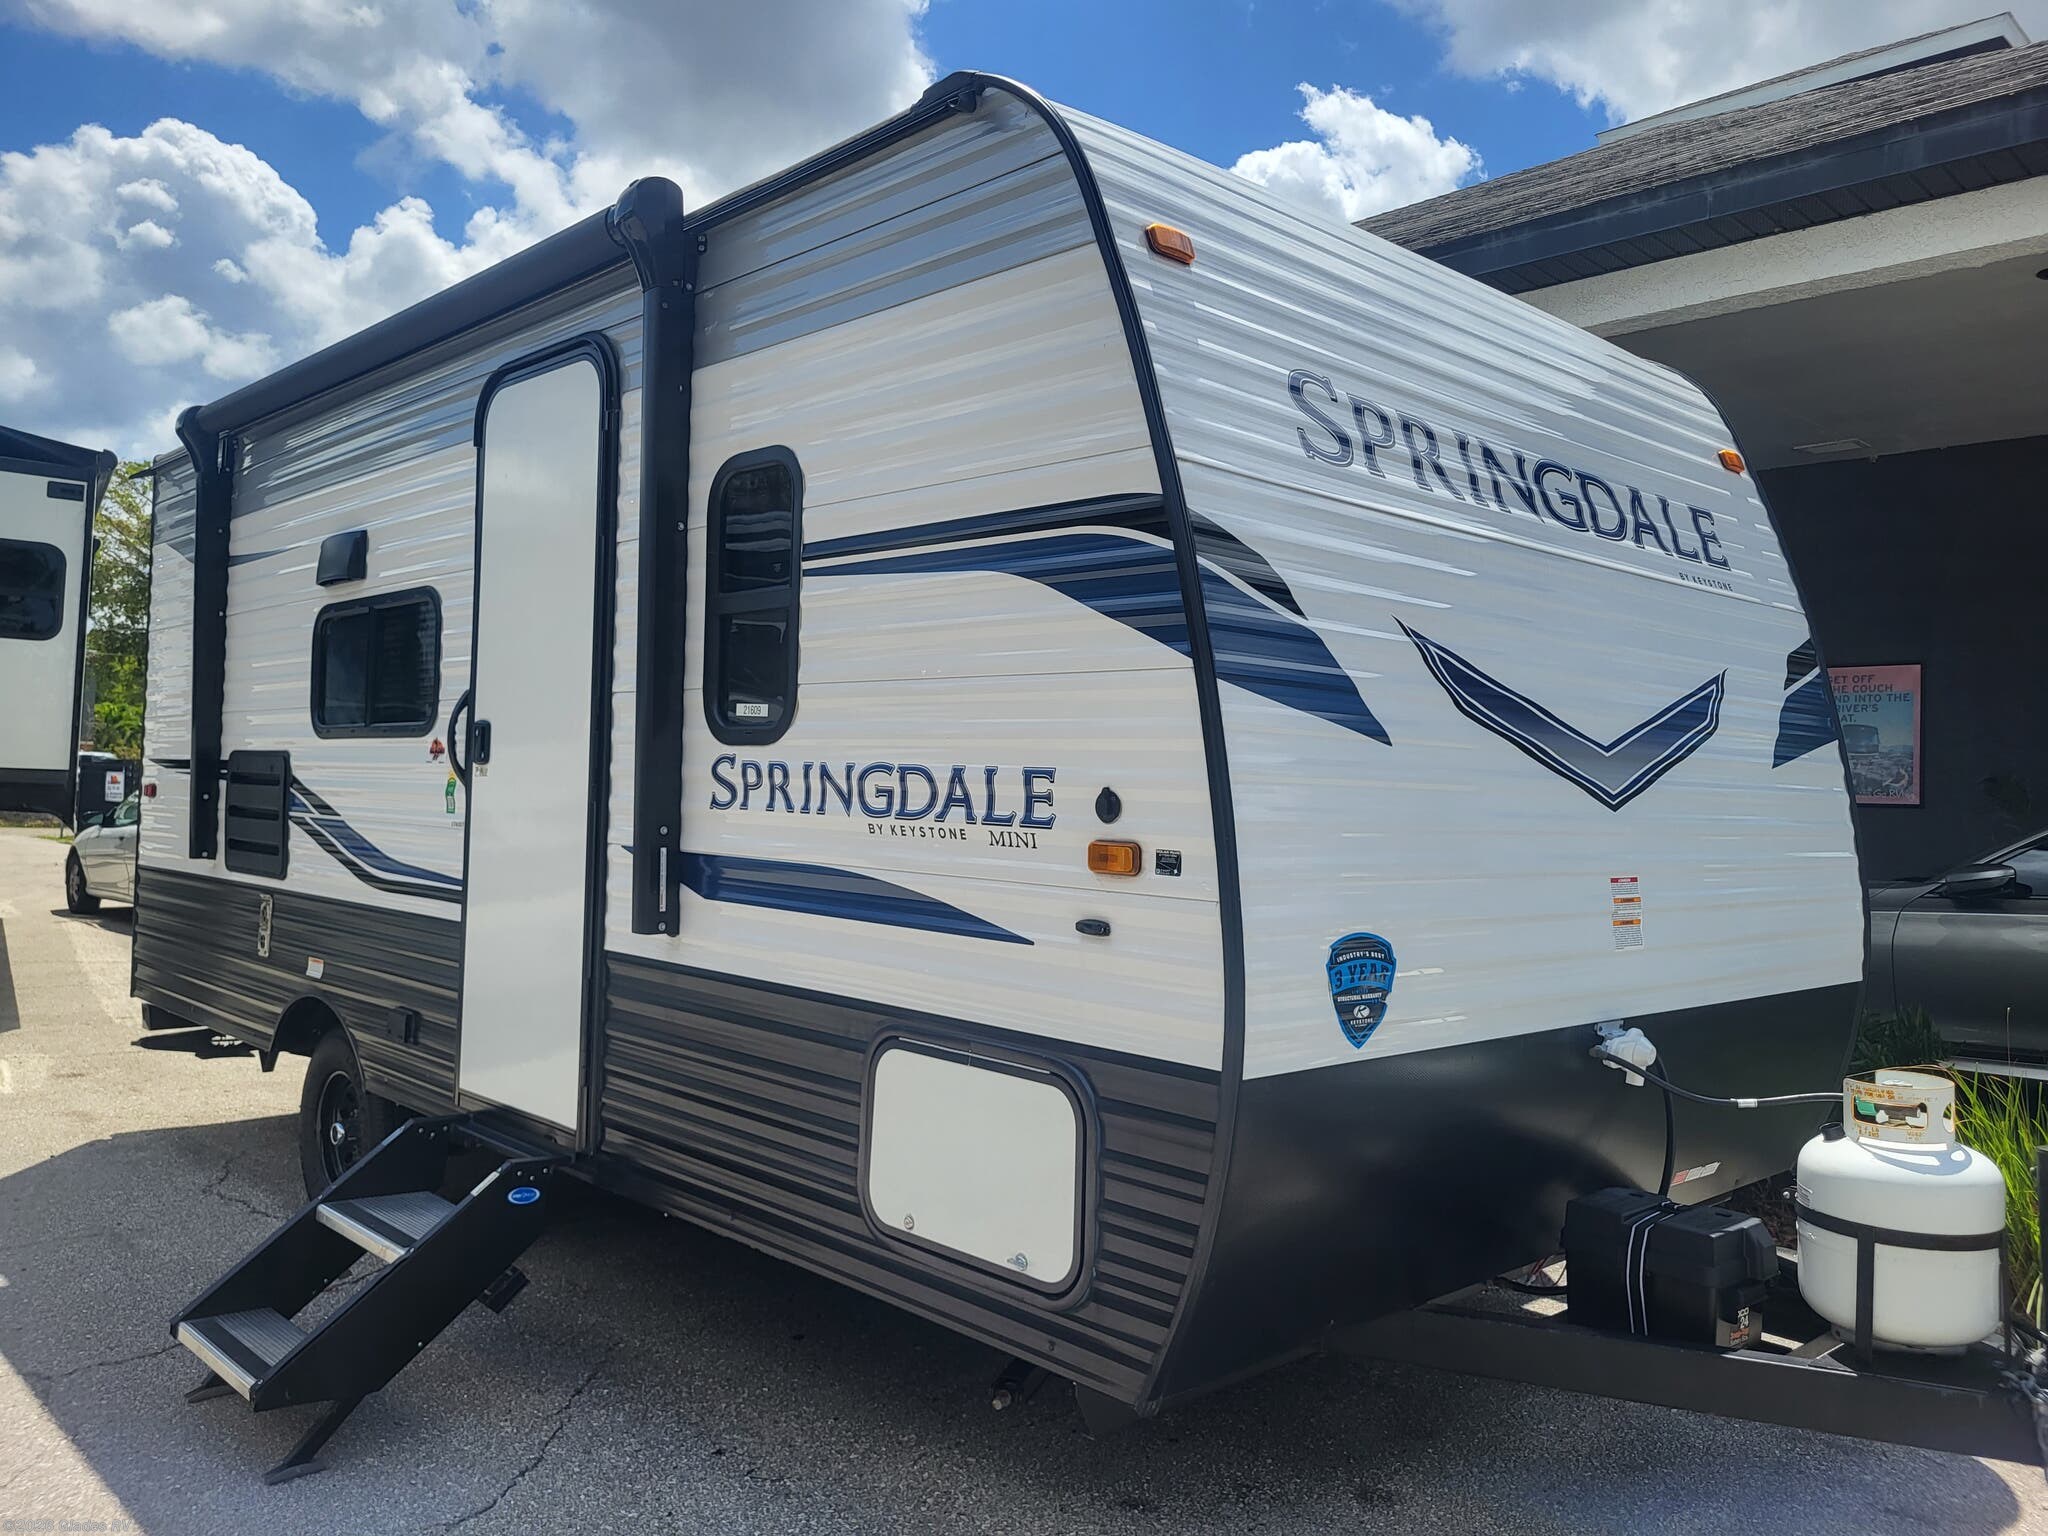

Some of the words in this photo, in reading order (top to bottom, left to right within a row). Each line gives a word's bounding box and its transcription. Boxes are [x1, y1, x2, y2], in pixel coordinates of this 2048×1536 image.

[1287, 367, 1732, 572] SPRINGDALE
[1678, 572, 1690, 582] BY
[1691, 575, 1734, 592] KEYSTONE
[1852, 674, 1876, 684] OFF
[1832, 684, 1849, 694] HE
[1853, 683, 1893, 693] COUCH
[1834, 694, 1850, 704] ND
[1854, 693, 1882, 703] INTO
[1887, 692, 1911, 703] THE
[1836, 703, 1879, 713] RIVER'S
[709, 752, 1058, 830] SPRINGDALE
[868, 823, 884, 836] BY
[890, 823, 968, 841] KEYSTONE
[988, 831, 1039, 850] MINI
[1335, 970, 1343, 989] 3
[1348, 963, 1389, 984] YEAR
